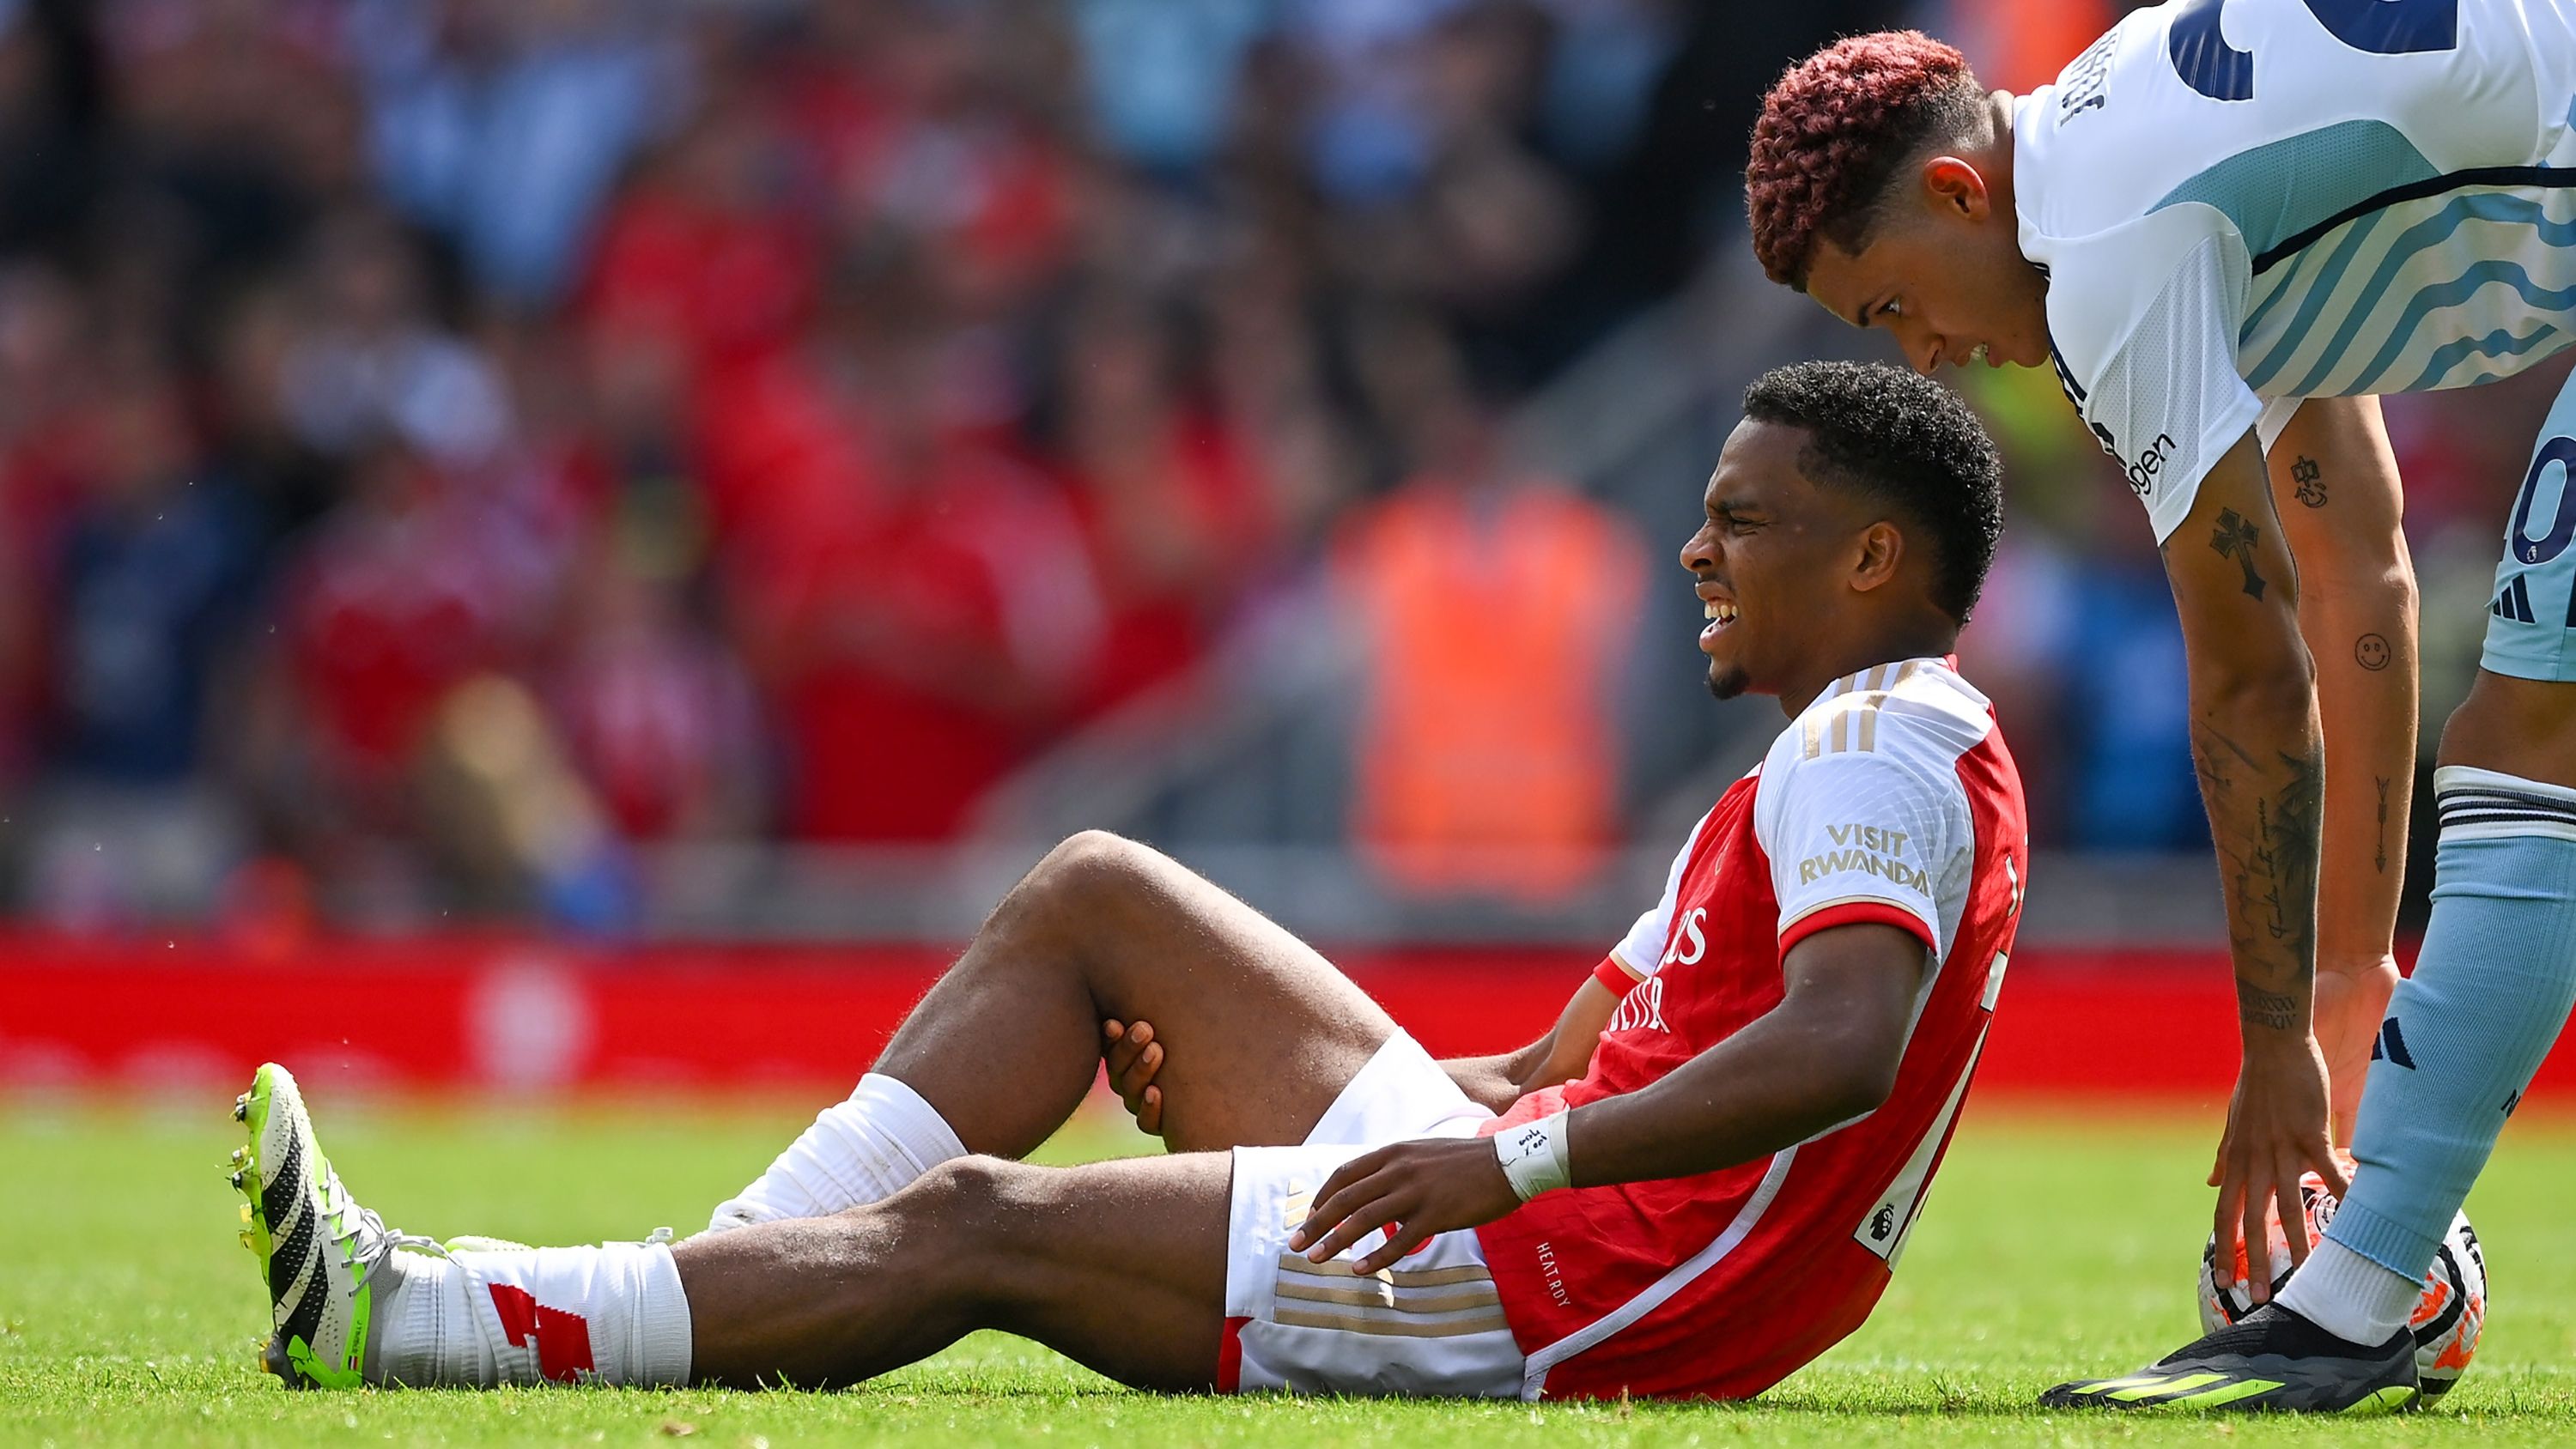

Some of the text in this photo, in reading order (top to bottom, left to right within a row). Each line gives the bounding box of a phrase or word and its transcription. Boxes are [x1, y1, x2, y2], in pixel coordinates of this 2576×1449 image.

[1826, 824, 1908, 858] VISIT
[1800, 850, 1929, 898] RWANDA
[1536, 1242, 1571, 1307] HEAT.RDY
